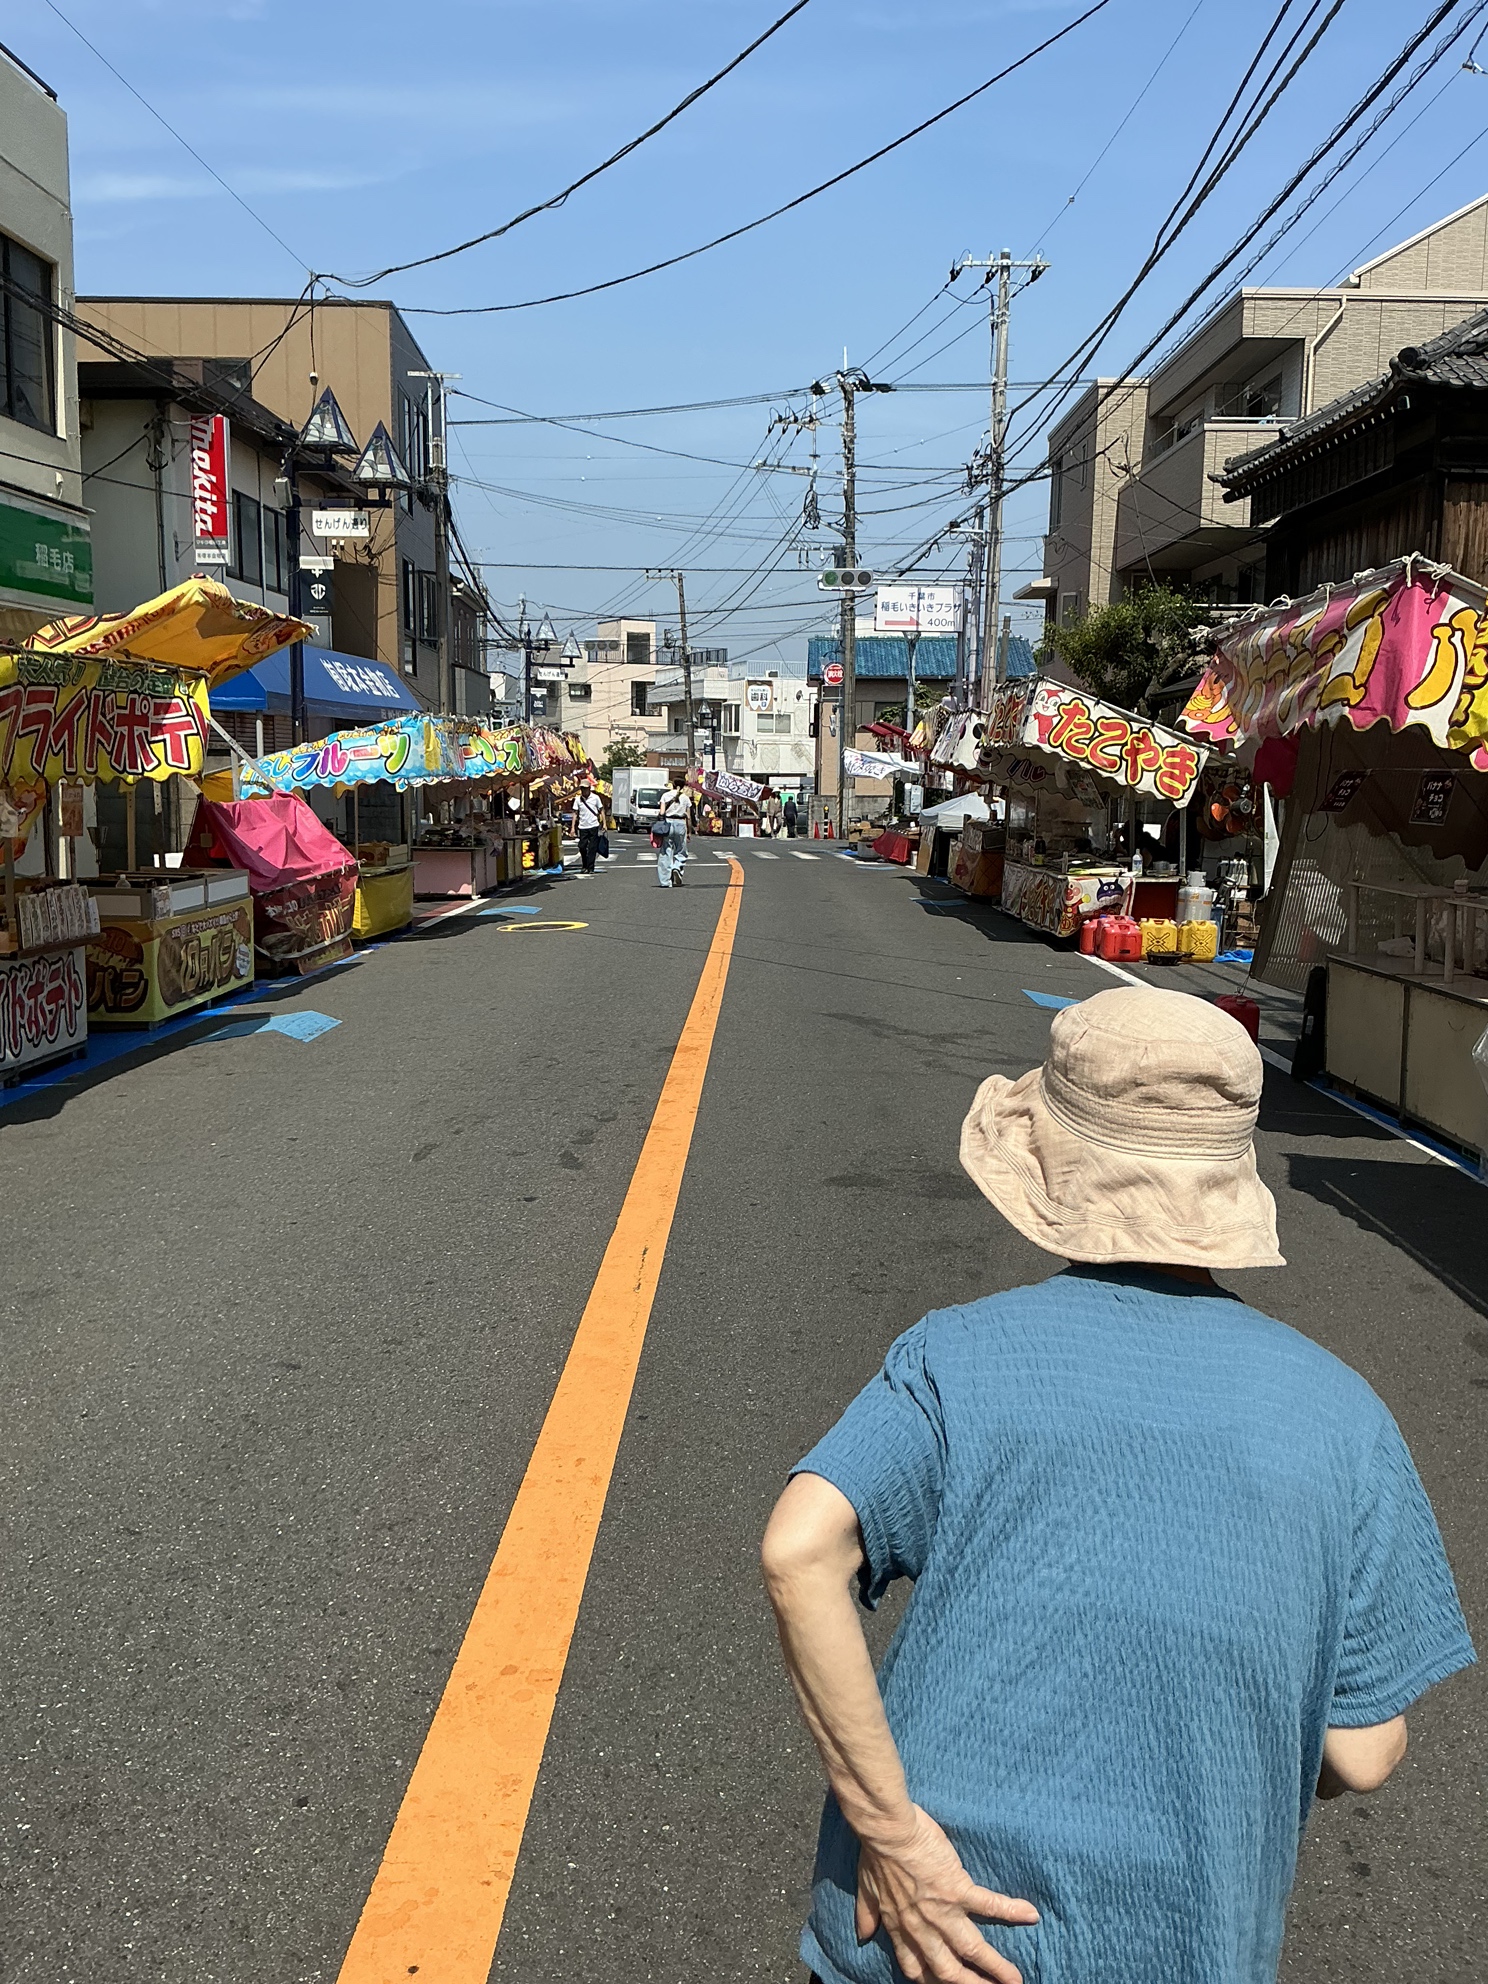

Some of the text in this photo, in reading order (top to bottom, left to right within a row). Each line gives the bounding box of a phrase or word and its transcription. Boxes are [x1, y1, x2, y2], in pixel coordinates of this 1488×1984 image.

[191, 414, 217, 537] makita
[315, 517, 368, 530] せんげん通り
[35, 542, 74, 573] 稲毛店
[908, 591, 935, 600] 千葉市
[881, 601, 962, 613] 稲毛いきいきプラザ
[927, 618, 956, 627] 400m
[751, 692, 768, 701] 歯科
[1049, 698, 1200, 801] たこやき
[291, 732, 411, 783] フルーツ
